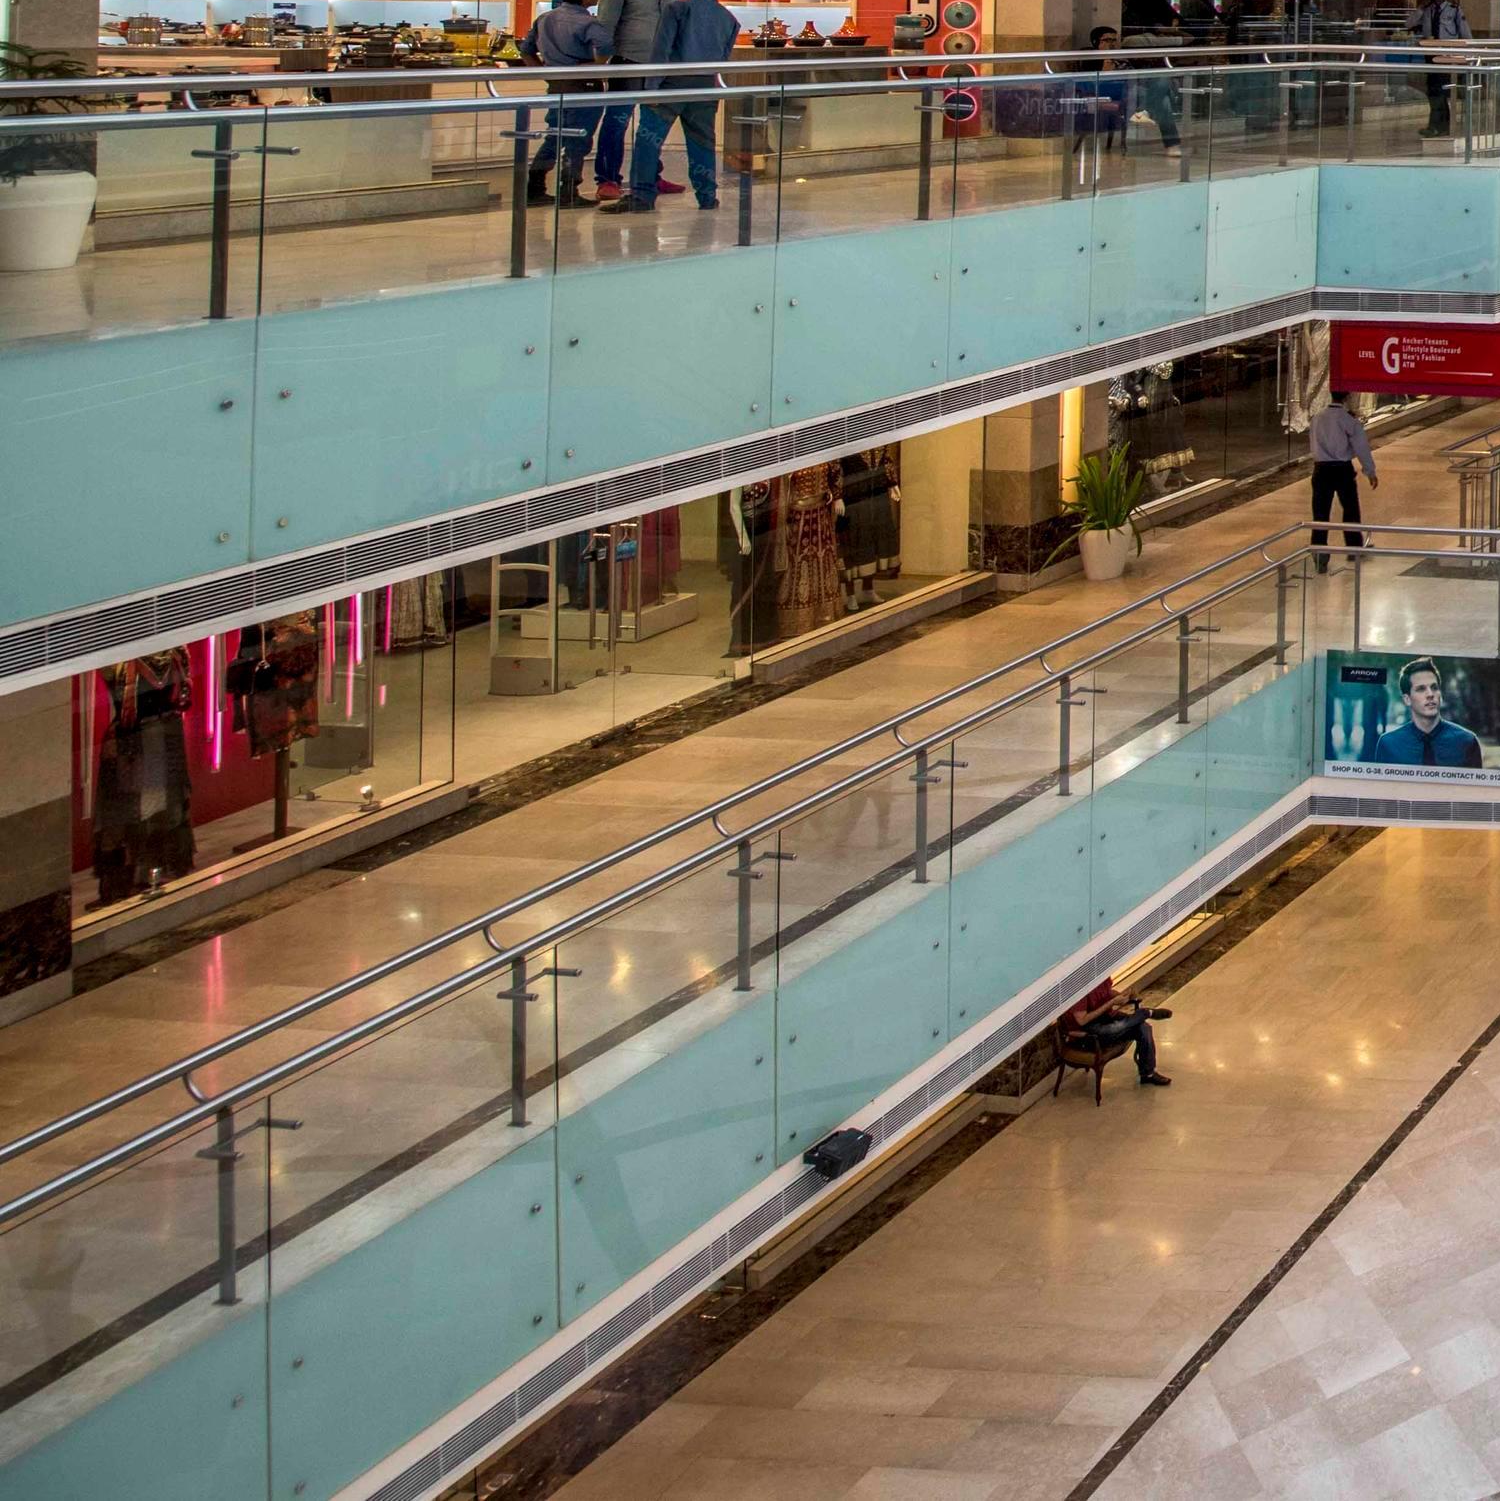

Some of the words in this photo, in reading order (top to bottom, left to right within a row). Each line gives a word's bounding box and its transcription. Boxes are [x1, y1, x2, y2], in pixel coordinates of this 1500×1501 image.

[1424, 338, 1449, 346] Tenants
[1402, 345, 1428, 354] Lifestyle
[1358, 350, 1375, 360] LEVEL
[1381, 336, 1399, 375] G
[1402, 353, 1420, 361] Men's
[1421, 354, 1446, 362] Fashion
[1350, 669, 1378, 677] ARROW
[1385, 769, 1415, 777] GROUND
[1416, 770, 1440, 778] FLOOR
[1441, 771, 1474, 780] CONTACT
